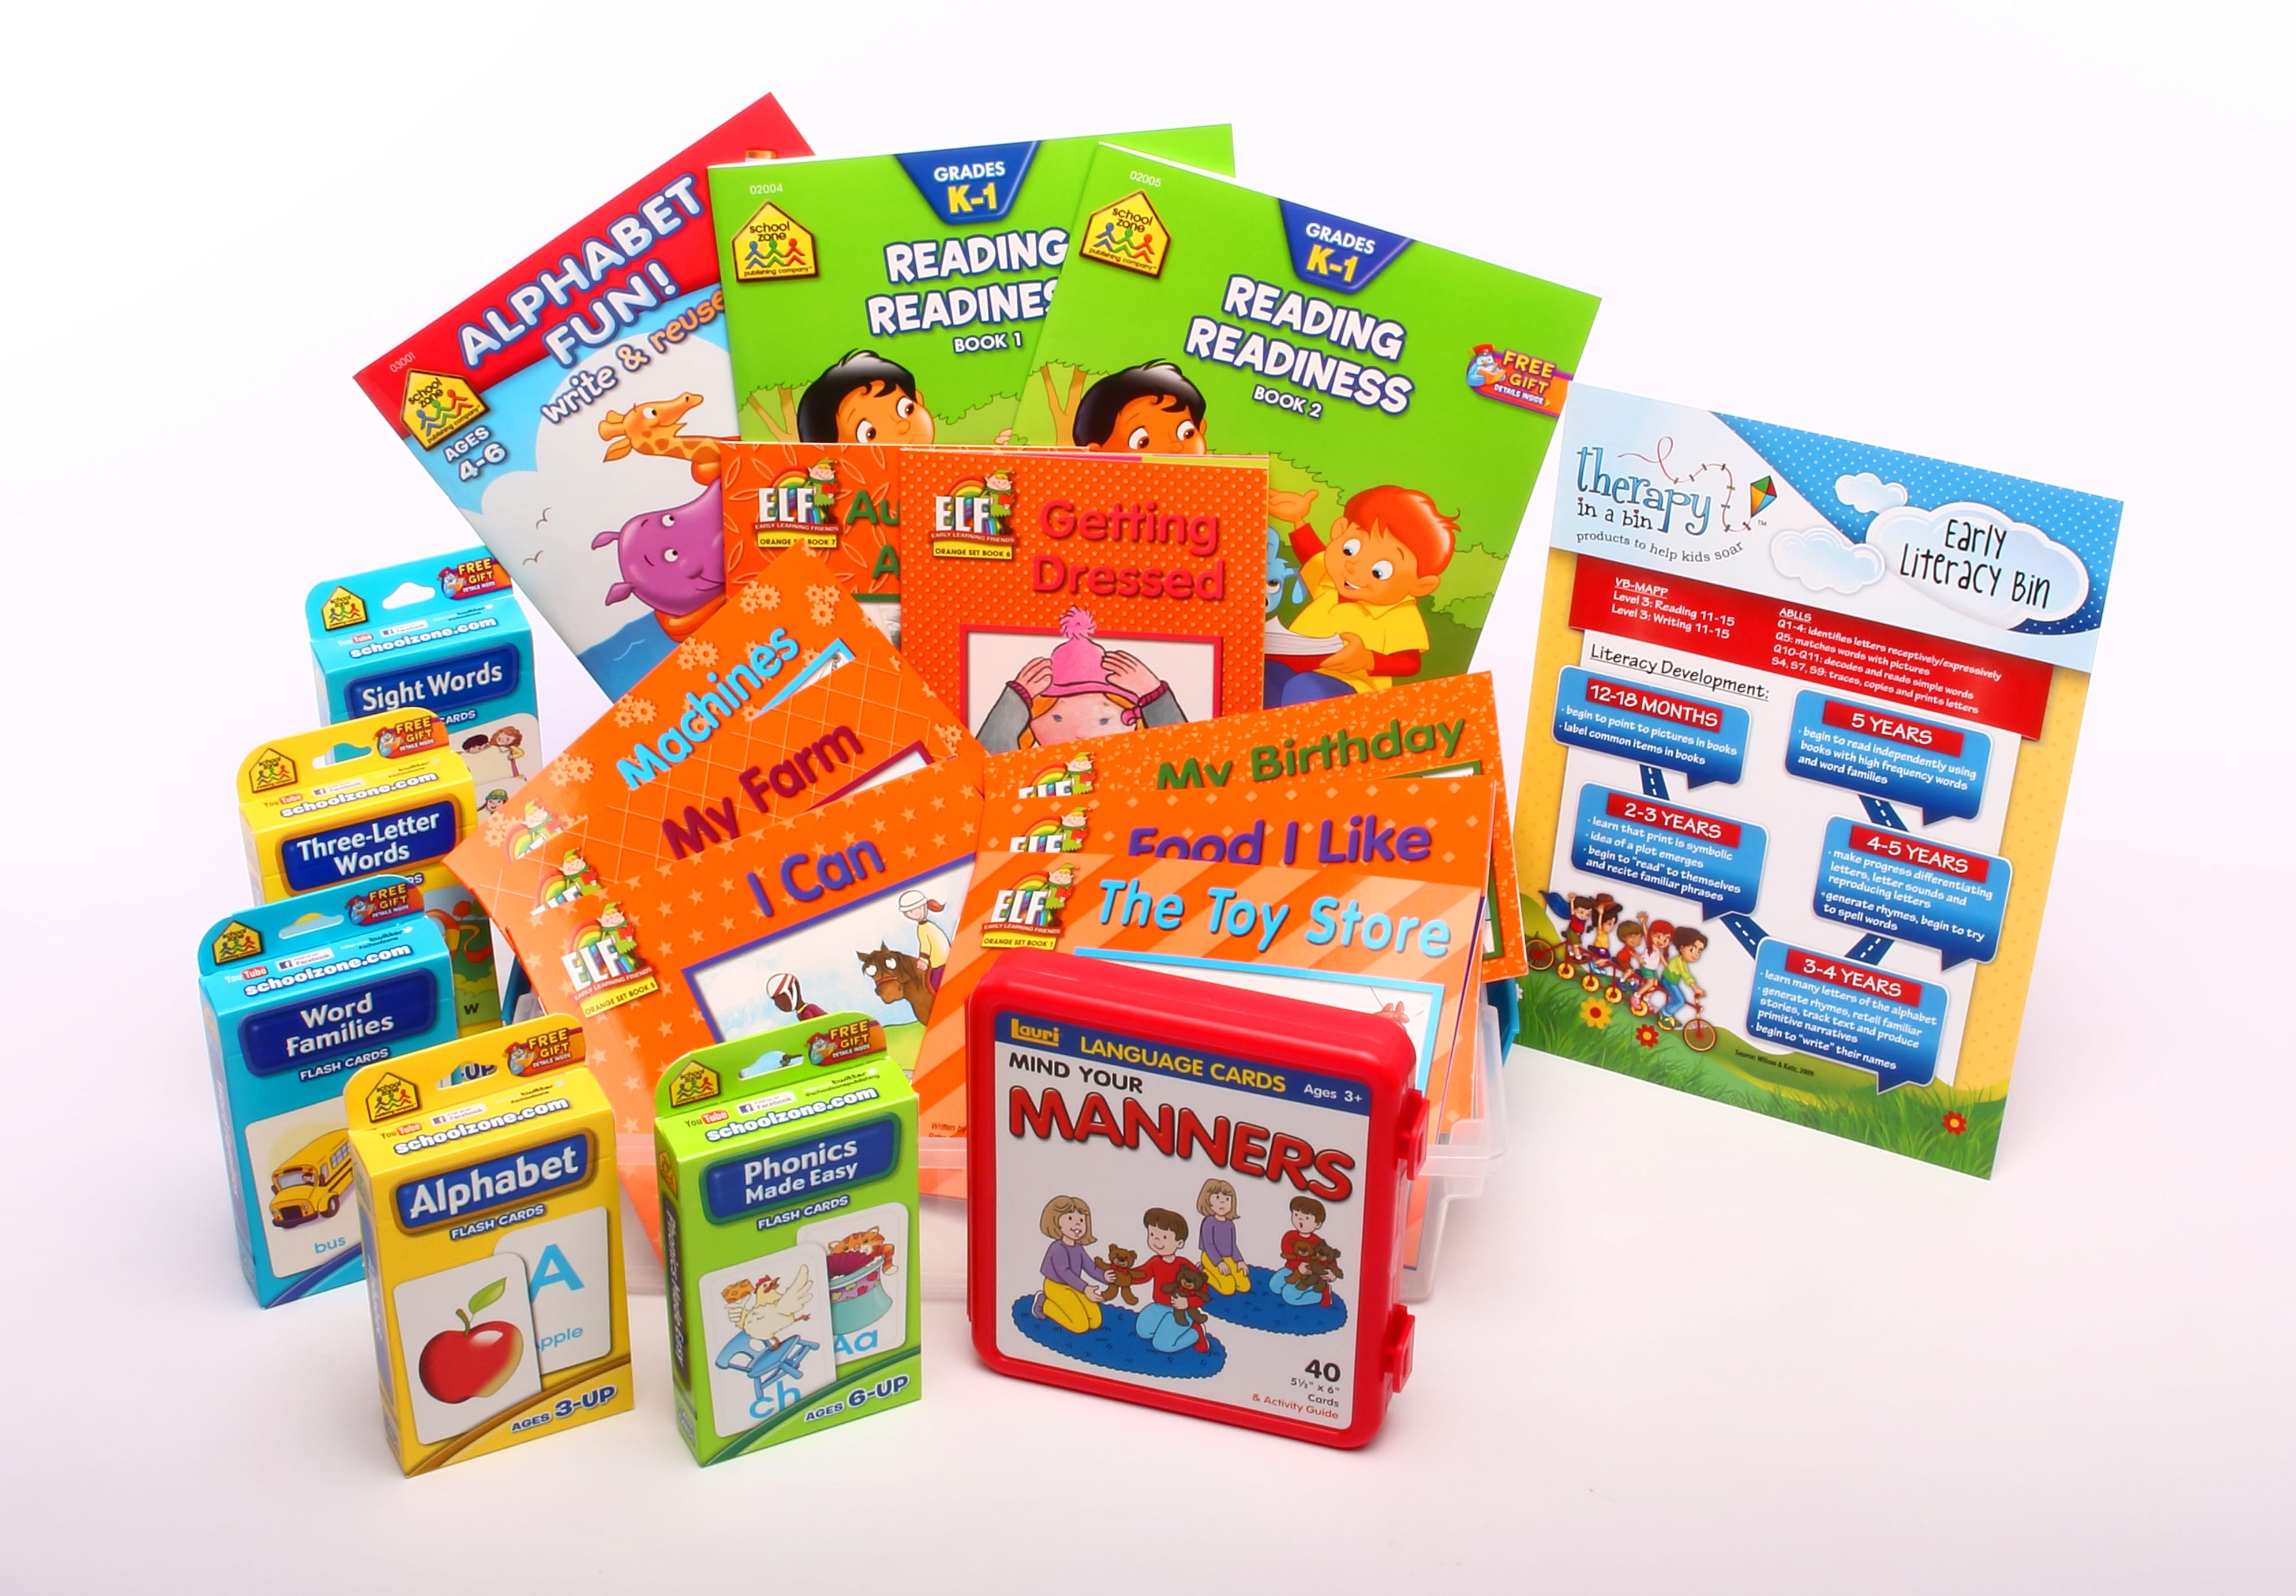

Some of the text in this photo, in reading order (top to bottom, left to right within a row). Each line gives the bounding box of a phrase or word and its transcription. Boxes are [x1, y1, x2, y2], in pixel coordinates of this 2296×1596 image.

[750, 183, 783, 194] 02004
[934, 162, 1005, 181] GRADES
[1129, 171, 1162, 188] 02005
[947, 182, 998, 213] K-1
[1111, 206, 1153, 226] school
[749, 221, 790, 234] school
[758, 231, 786, 242] zone
[1116, 218, 1145, 233] zone
[1305, 222, 1375, 256] GRADES
[459, 175, 703, 368] ALPHABET
[883, 227, 1069, 283] READING
[1305, 243, 1358, 283] K-1
[542, 261, 677, 368] FUN!
[1223, 274, 1404, 362] READING
[541, 290, 724, 424] write & reuse
[954, 332, 1022, 354] BOOK 1
[389, 352, 415, 373] 03001
[1183, 316, 1414, 417] READINESS
[1501, 350, 1557, 379] FREE
[1253, 385, 1322, 418] BOOK 2
[1493, 384, 1545, 406] DETAILS INSIDE
[1508, 372, 1550, 394] GIFT
[443, 426, 490, 462] AGES
[459, 443, 506, 481] 4-6
[1576, 447, 1711, 536] therapy
[935, 496, 990, 534] ELF
[1039, 498, 1219, 556] Getting
[1577, 497, 1654, 531] in a bin
[930, 532, 1015, 543] EARLY LEARNING FRIENDS
[935, 548, 967, 556] ORANGE
[982, 549, 1003, 557] BOOK
[1576, 531, 1743, 563] products to help kids soar
[1944, 519, 2007, 560] Early
[1032, 553, 1226, 601] Dressed
[1615, 576, 1668, 598] VB-MAPP
[1900, 544, 2002, 597] Literacy
[1612, 604, 1731, 639] Level 3: Writing 11-15
[1613, 591, 1736, 627] Level 3: Reading 11-15
[349, 616, 498, 659] schoolzone.com
[362, 661, 503, 711] Sight Words
[1590, 643, 1770, 700] Literacy Development:
[616, 627, 800, 791] Machines
[1590, 684, 1718, 728] 12-18 MONTHS
[1565, 705, 1737, 756] begin to point to pictures in books
[1851, 713, 1932, 745] 5 YEARS
[1250, 718, 1466, 783] Birthday
[1797, 756, 1888, 785] and word families
[280, 772, 439, 818] schoolzone.com
[661, 725, 864, 861] My Farm
[296, 811, 440, 862] Three-Letter
[1624, 803, 1722, 838] 2-3 YEARS
[1127, 814, 1433, 866] Food I Like
[1867, 836, 1969, 874] 4-5 YEARS
[334, 843, 410, 876] Words
[746, 840, 886, 917] I Can
[369, 883, 407, 901] FREE
[380, 895, 407, 909] GIFT
[990, 889, 1047, 927] ELF
[1098, 878, 1452, 959] The Toy Store
[1823, 904, 1898, 931] to spell words
[244, 944, 411, 997] schoolzone.com
[560, 938, 626, 991] ELF
[1803, 958, 1902, 998] 3-4 YEARS
[300, 992, 373, 1029] Word
[286, 1015, 395, 1057] Families
[527, 1028, 568, 1050] FREE
[829, 1020, 870, 1040] FREE
[840, 1034, 870, 1050] GIFT
[299, 1048, 389, 1082] FLASH CARDS
[540, 1041, 570, 1059] GIFT
[1010, 1018, 1363, 1103] Lauri LANGUAGE CARDS Ages 3+
[1009, 1052, 1144, 1094] MIND YOUR
[394, 1097, 570, 1155] schoolzone.com
[706, 1087, 878, 1142] schoolzone.com
[1009, 1084, 1356, 1202] MANNERS
[743, 1140, 858, 1186] Phonics
[410, 1145, 579, 1220] Alphabet
[745, 1161, 859, 1205] Made Easy
[451, 1204, 545, 1240] FLASH CARDS
[758, 1195, 849, 1231] FLASH CARDS
[314, 1236, 346, 1254] bus
[530, 1243, 585, 1303] A
[535, 1325, 584, 1352] pple
[834, 1329, 879, 1356] Aa
[1305, 1359, 1341, 1383] 40
[511, 1385, 616, 1433] AGES 3-UP
[749, 1381, 801, 1420] ch
[805, 1375, 909, 1422] AGES 6-UP
[1252, 1393, 1339, 1419] & Activity Guide
[1308, 1393, 1339, 1407] Cards
